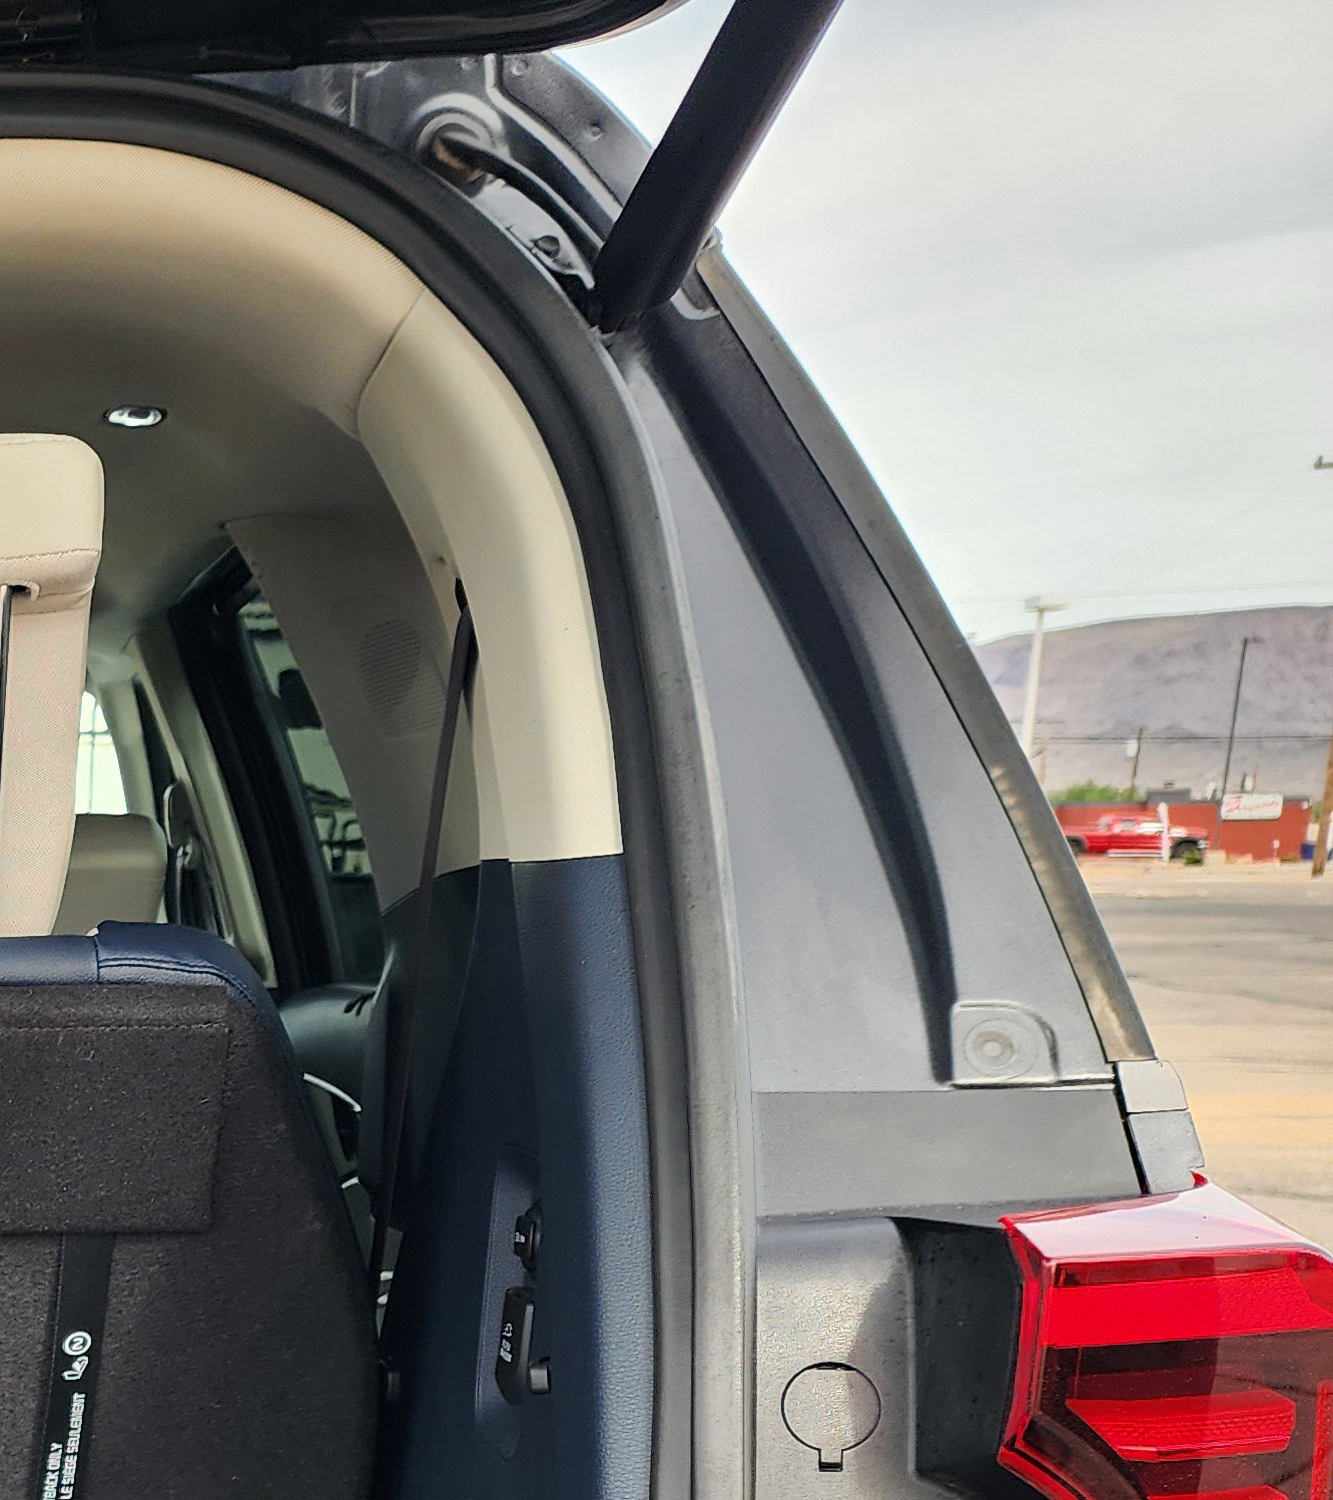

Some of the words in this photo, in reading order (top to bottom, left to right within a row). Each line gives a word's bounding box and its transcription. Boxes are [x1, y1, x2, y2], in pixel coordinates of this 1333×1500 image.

[65, 1392, 85, 1453] SEULEMENT
[46, 1442, 62, 1470] ONLY
[59, 1486, 73, 1499] LE
